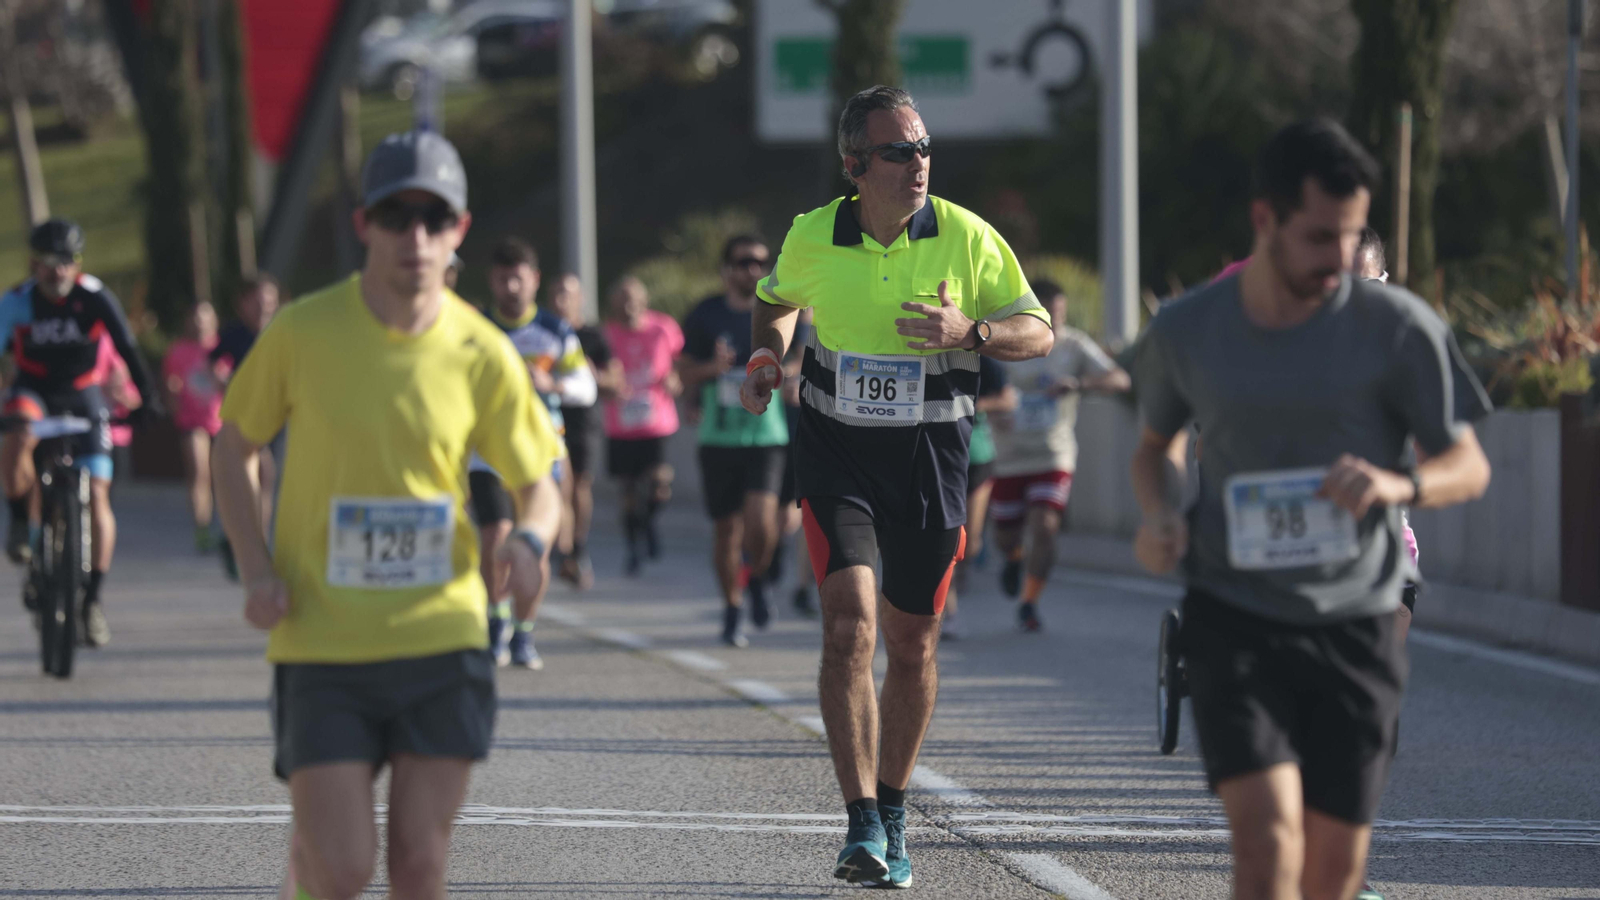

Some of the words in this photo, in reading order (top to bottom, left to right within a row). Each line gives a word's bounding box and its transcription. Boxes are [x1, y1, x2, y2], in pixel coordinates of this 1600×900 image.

[862, 363, 898, 372] MARATÓN
[856, 375, 897, 402] 196
[856, 405, 896, 416] EVOS
[1266, 502, 1307, 540] 98
[362, 525, 416, 562] 128
